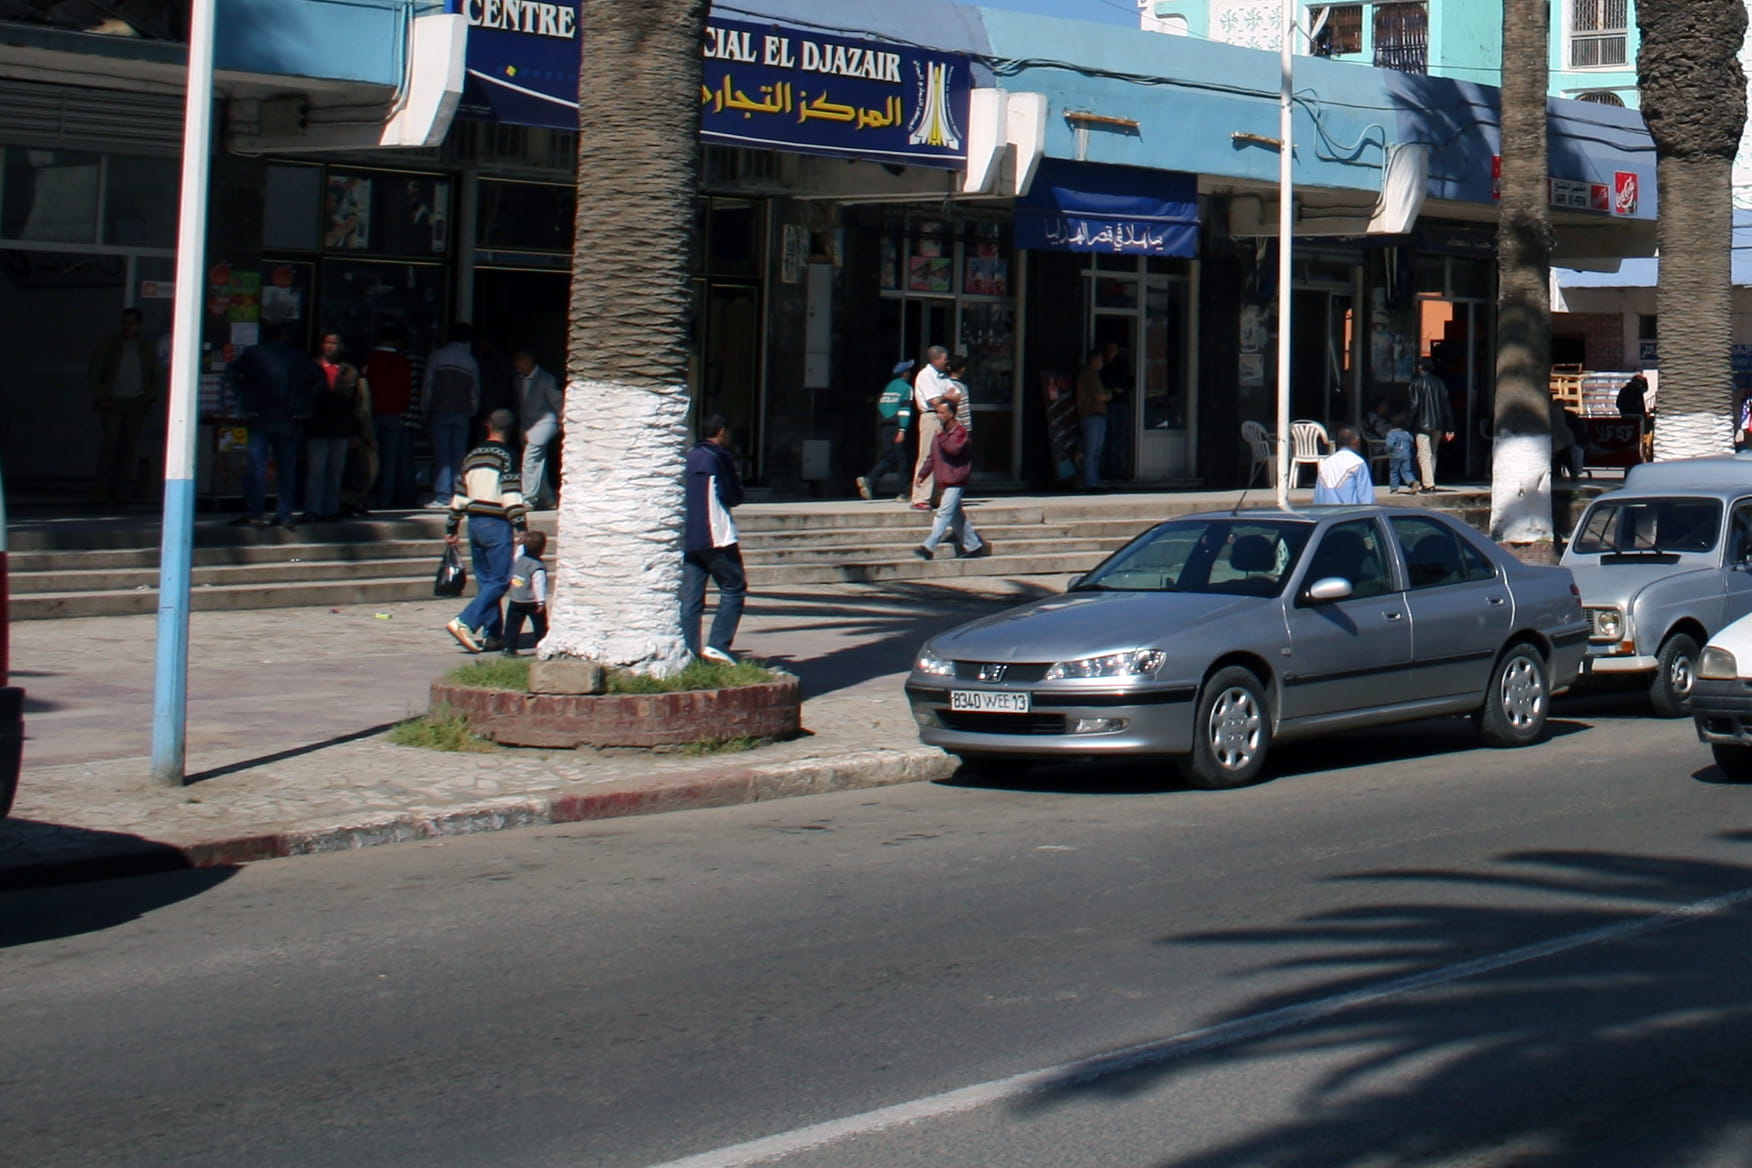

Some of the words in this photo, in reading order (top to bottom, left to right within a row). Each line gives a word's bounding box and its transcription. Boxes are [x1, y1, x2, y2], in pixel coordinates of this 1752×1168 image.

[703, 26, 757, 63] CIAL
[764, 35, 795, 68] EL
[801, 40, 901, 83] DJAZAIR
[797, 89, 902, 131] المركز
[953, 693, 981, 709] 8340
[1012, 694, 1026, 711] 13
